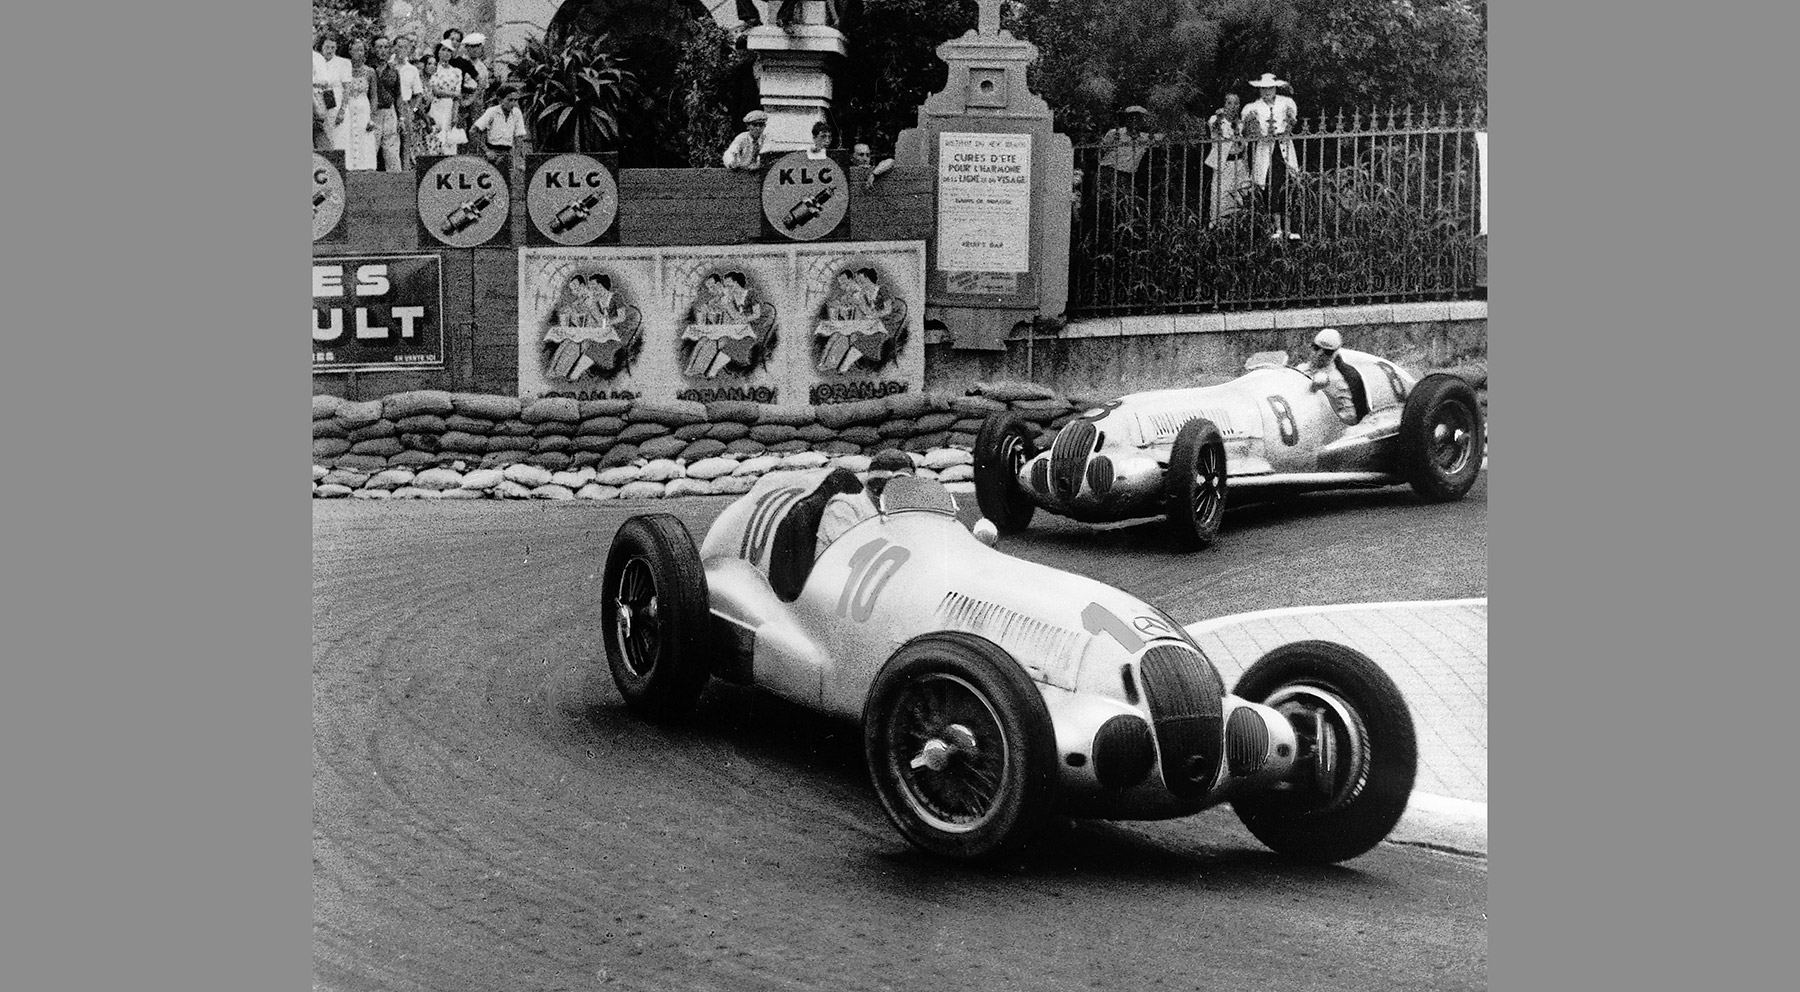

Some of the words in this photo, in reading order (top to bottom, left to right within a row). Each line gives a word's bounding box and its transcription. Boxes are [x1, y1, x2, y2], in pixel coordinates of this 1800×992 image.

[948, 164, 971, 172] POUR
[313, 264, 390, 297] ES
[815, 381, 902, 400] ORANJO
[1266, 395, 1299, 447] 8
[835, 537, 911, 623] 10
